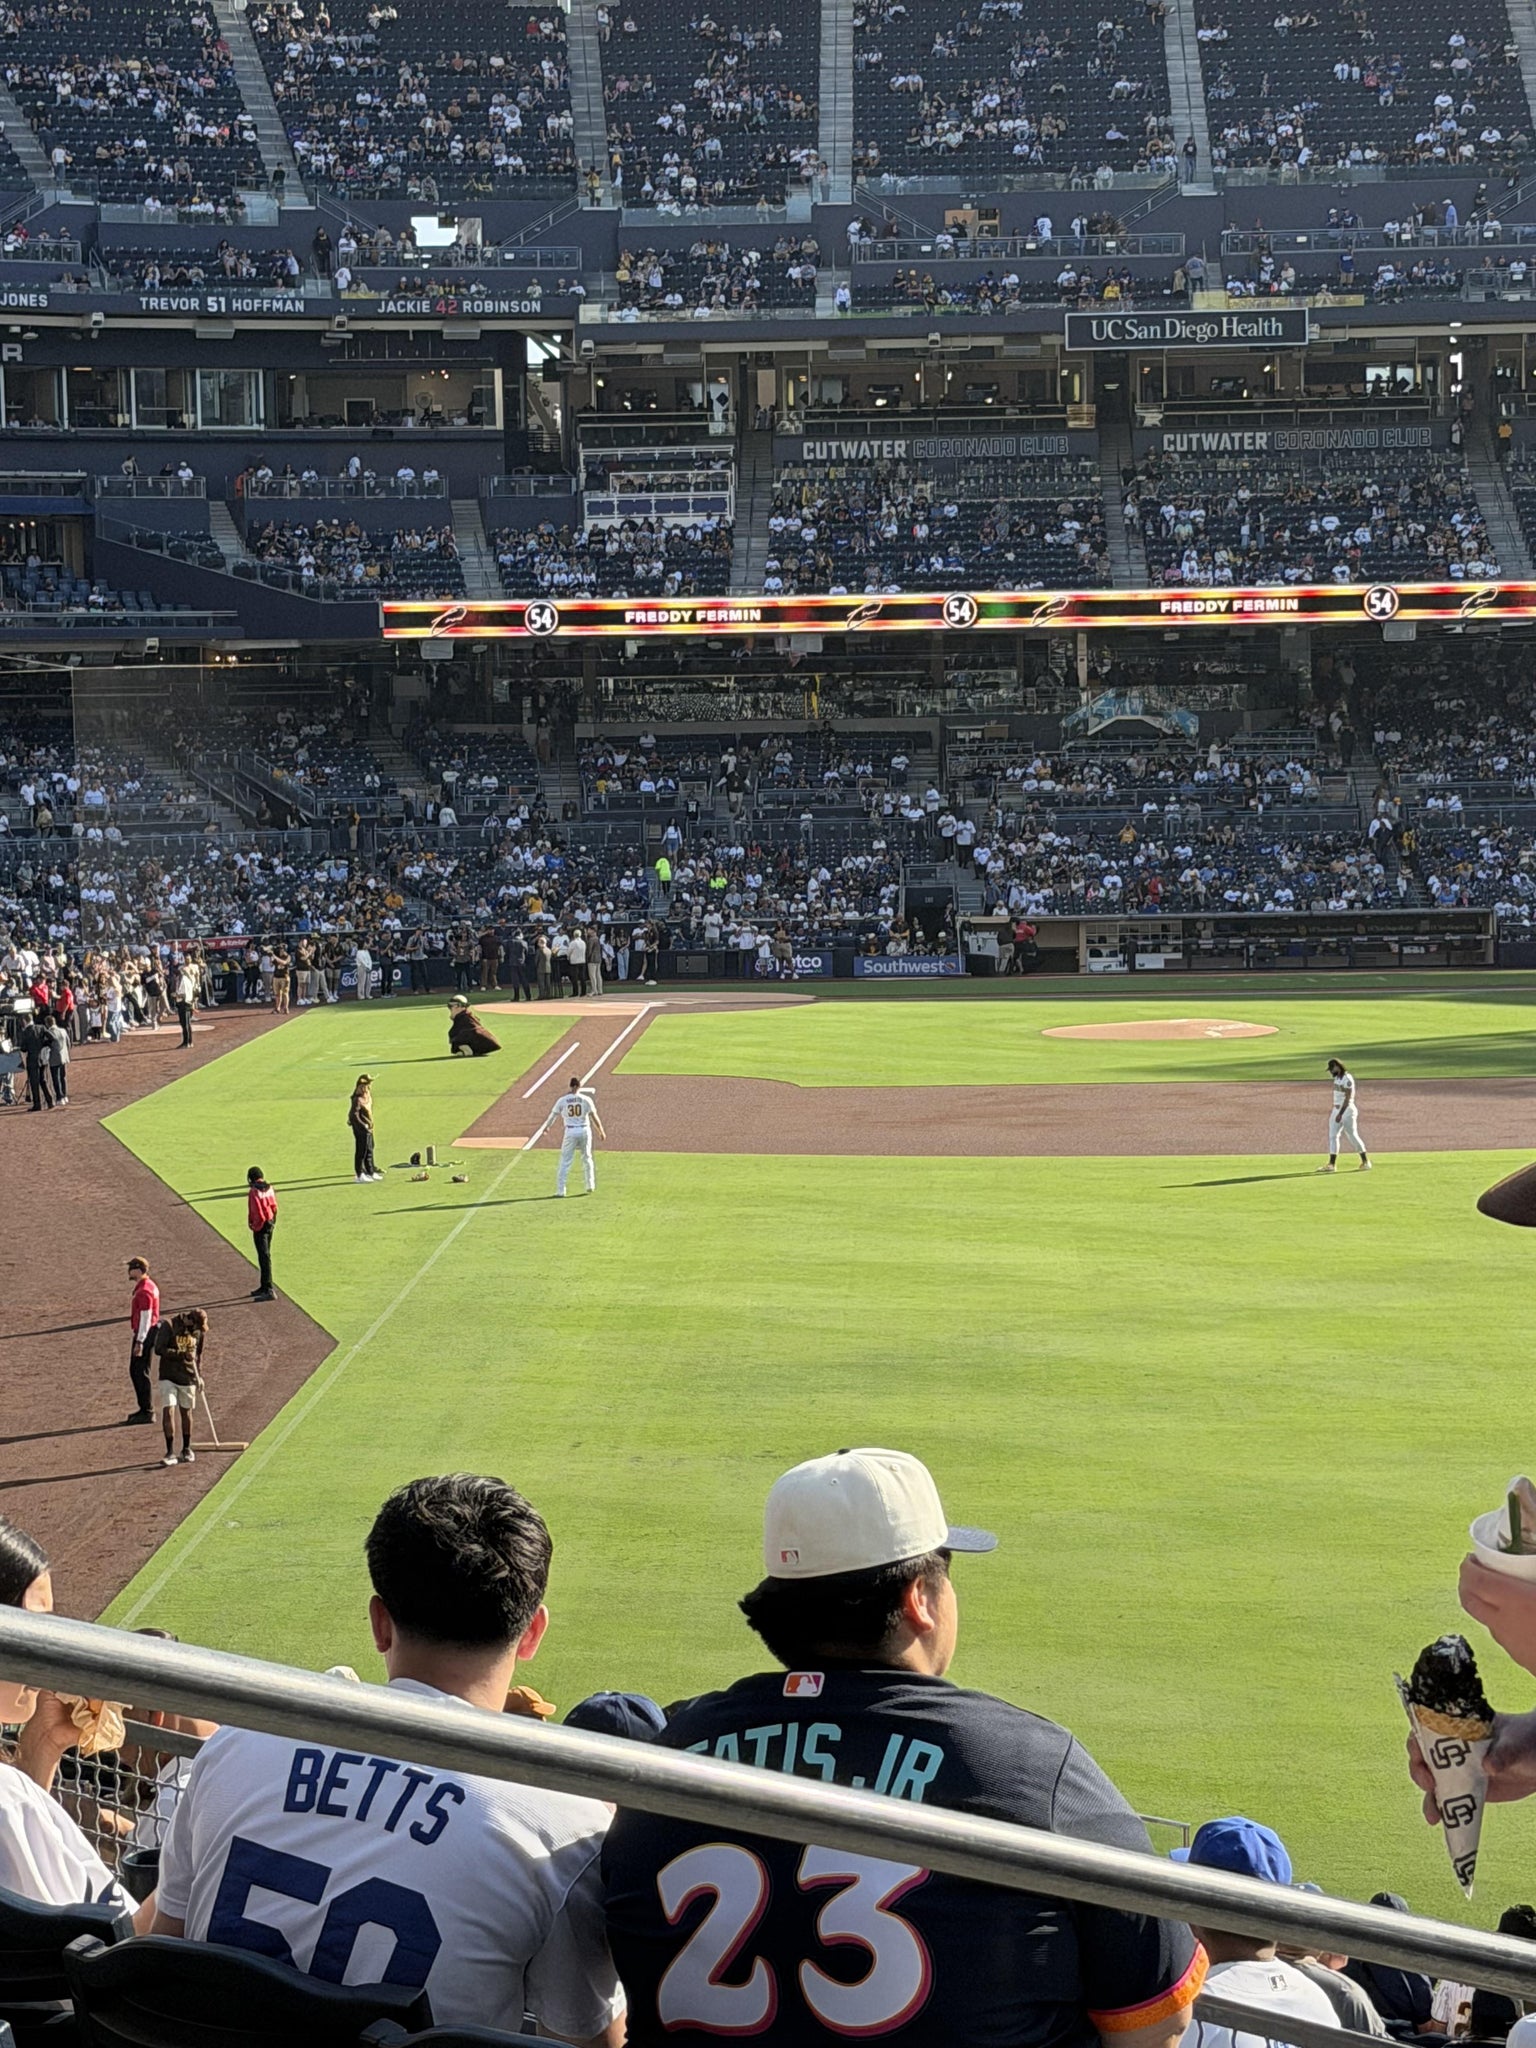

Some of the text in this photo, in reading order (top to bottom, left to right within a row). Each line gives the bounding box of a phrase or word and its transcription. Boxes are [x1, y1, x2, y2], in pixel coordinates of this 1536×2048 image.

[0, 293, 48, 308] JONES
[140, 296, 305, 313] TREVOR 51 HOFFMAN
[377, 300, 541, 315] JACKIE 42 ROBINSON
[1091, 317, 1283, 343] UC San Diego Health
[803, 436, 1069, 460] CUTWATER CORONADO CLUB
[1163, 427, 1431, 451] CUTWATER CORONADO CLUB
[949, 603, 971, 622] 54
[1160, 600, 1298, 613] FREDDY FERMIN
[1371, 593, 1391, 613] 54
[530, 608, 552, 629] 54
[625, 609, 761, 623] FREDDY FERMIN
[864, 959, 945, 974] Southwest
[567, 1104, 582, 1117] 30
[684, 1722, 842, 1783] ATIS
[283, 1747, 466, 1846] BETTS
[206, 1835, 443, 1990] 50
[656, 1842, 934, 2036] 23
